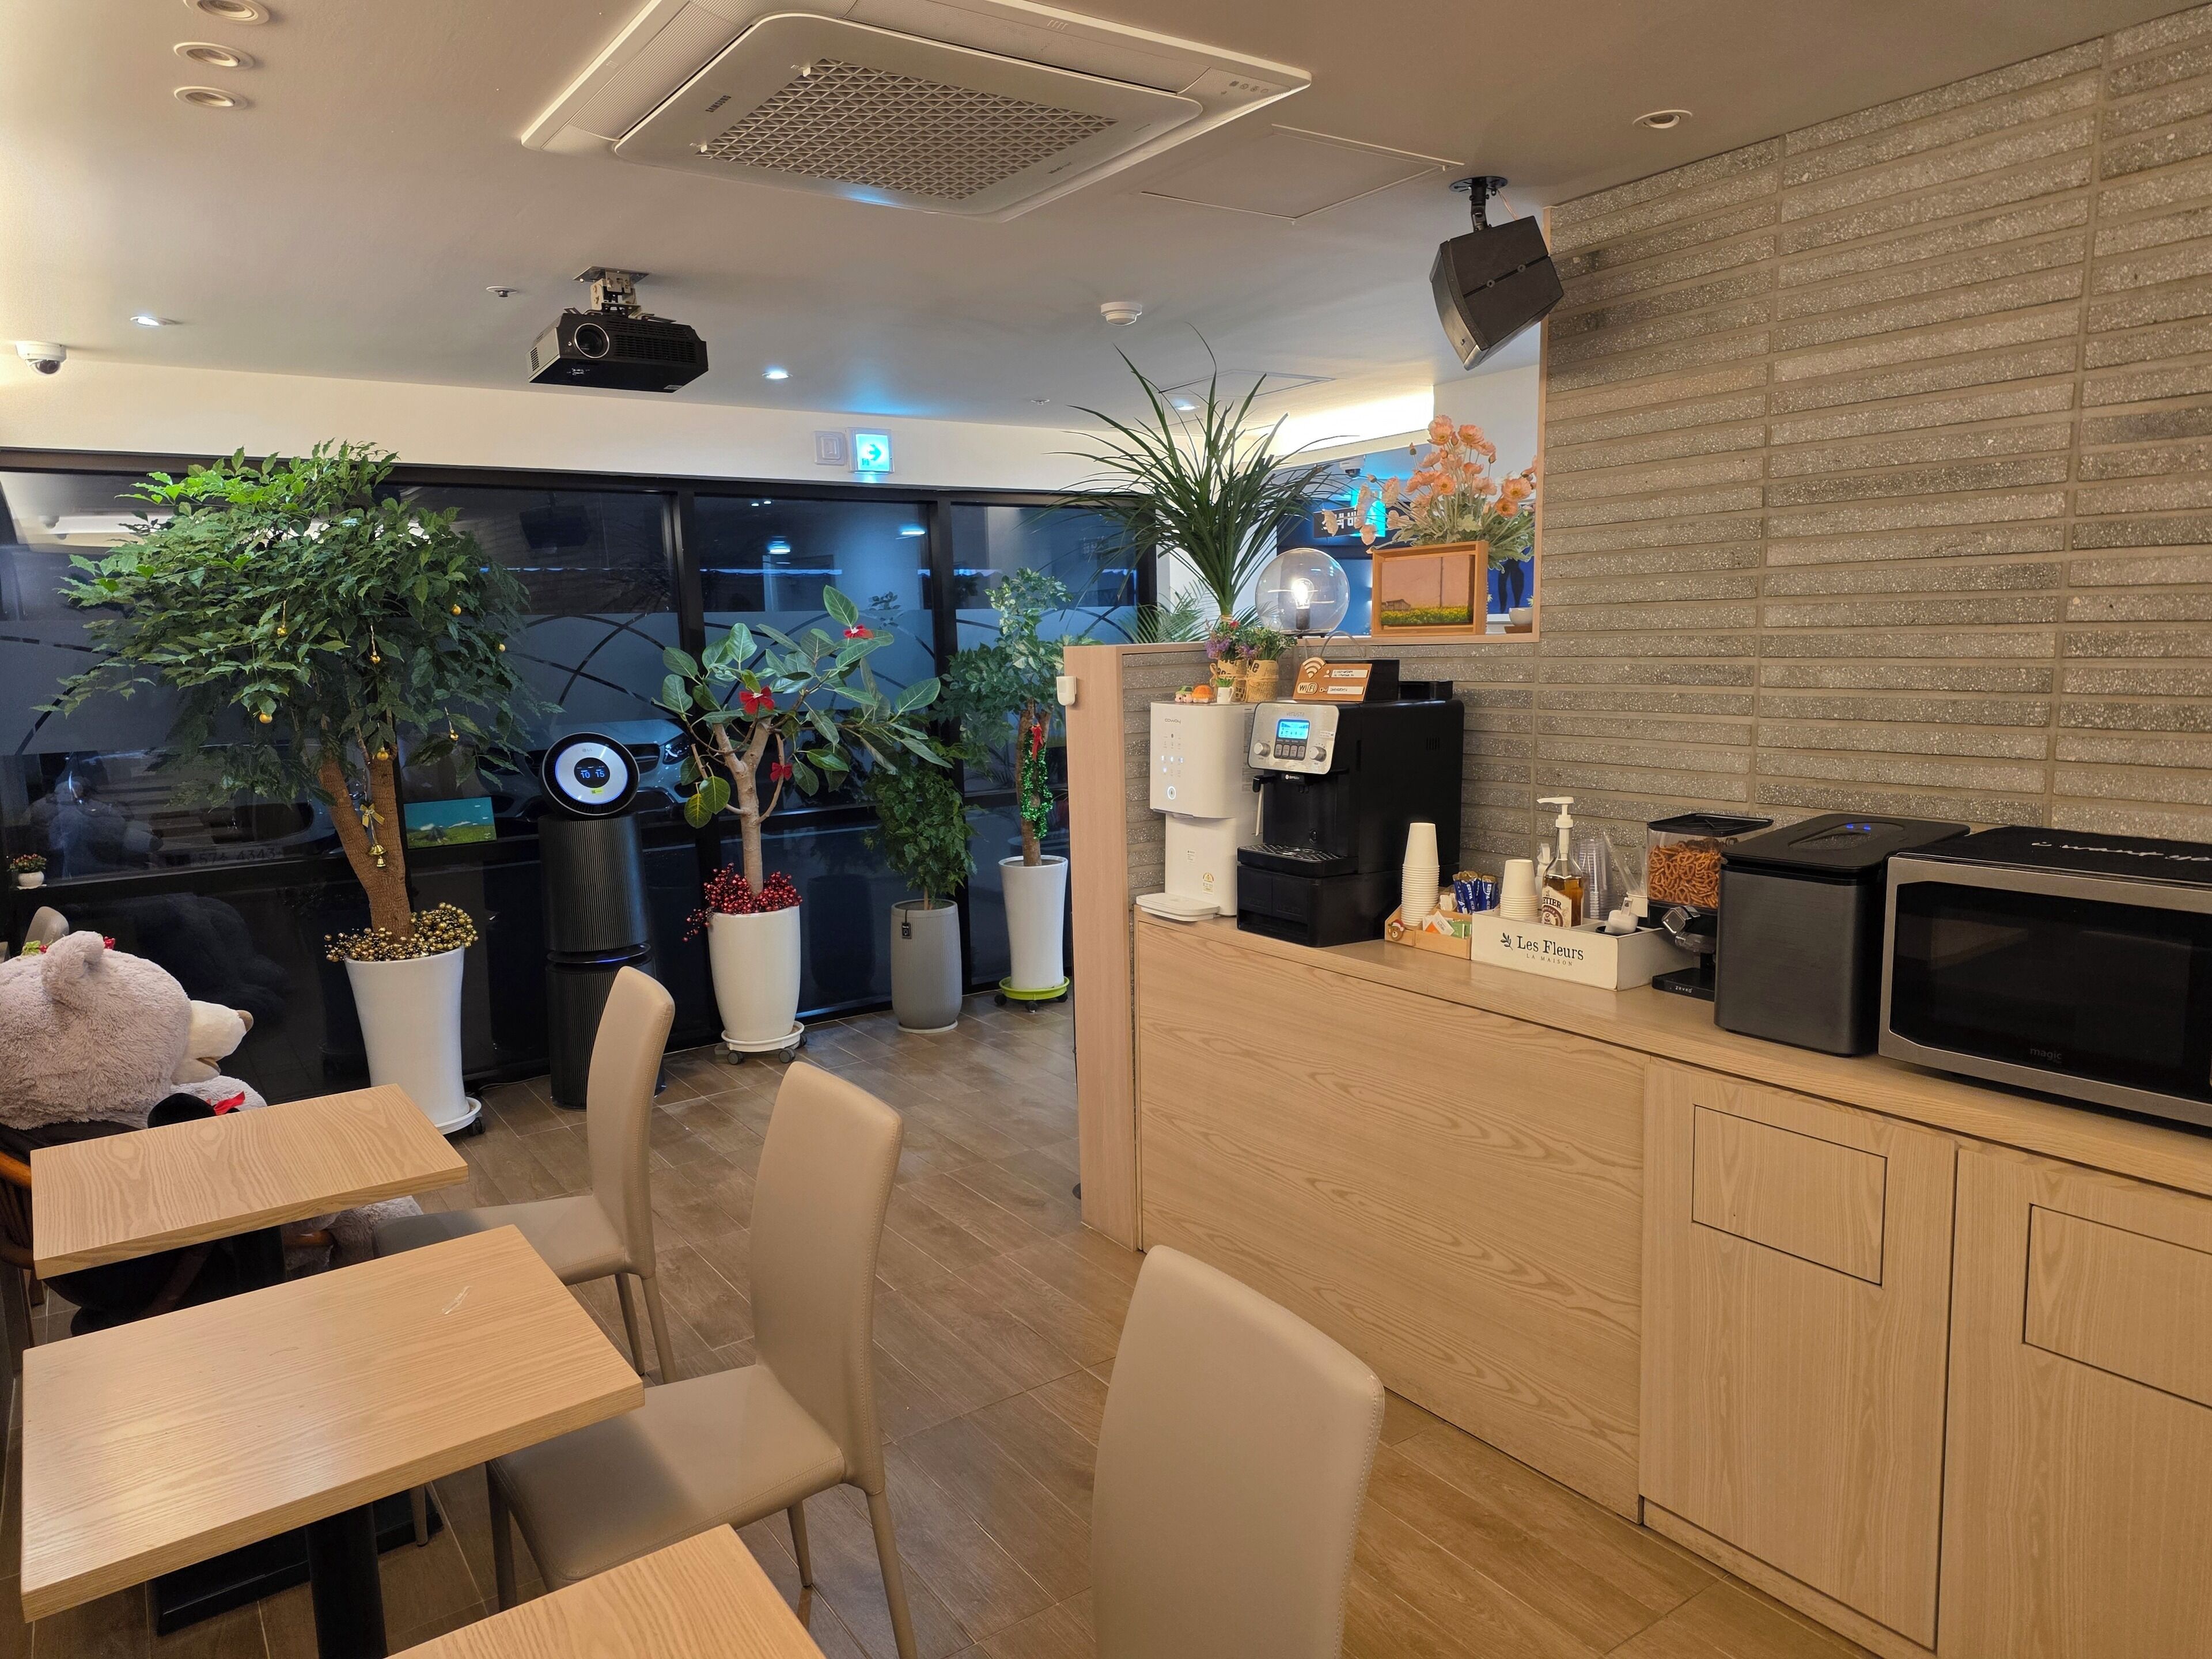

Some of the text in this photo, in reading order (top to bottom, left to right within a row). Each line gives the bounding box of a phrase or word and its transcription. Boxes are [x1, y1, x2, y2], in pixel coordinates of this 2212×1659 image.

[704, 94, 732, 113] SAMSUNG
[1516, 935, 1584, 961] Les Fleurs
[1541, 956, 1573, 966] MAISON
[2030, 1048, 2062, 1060] magic
